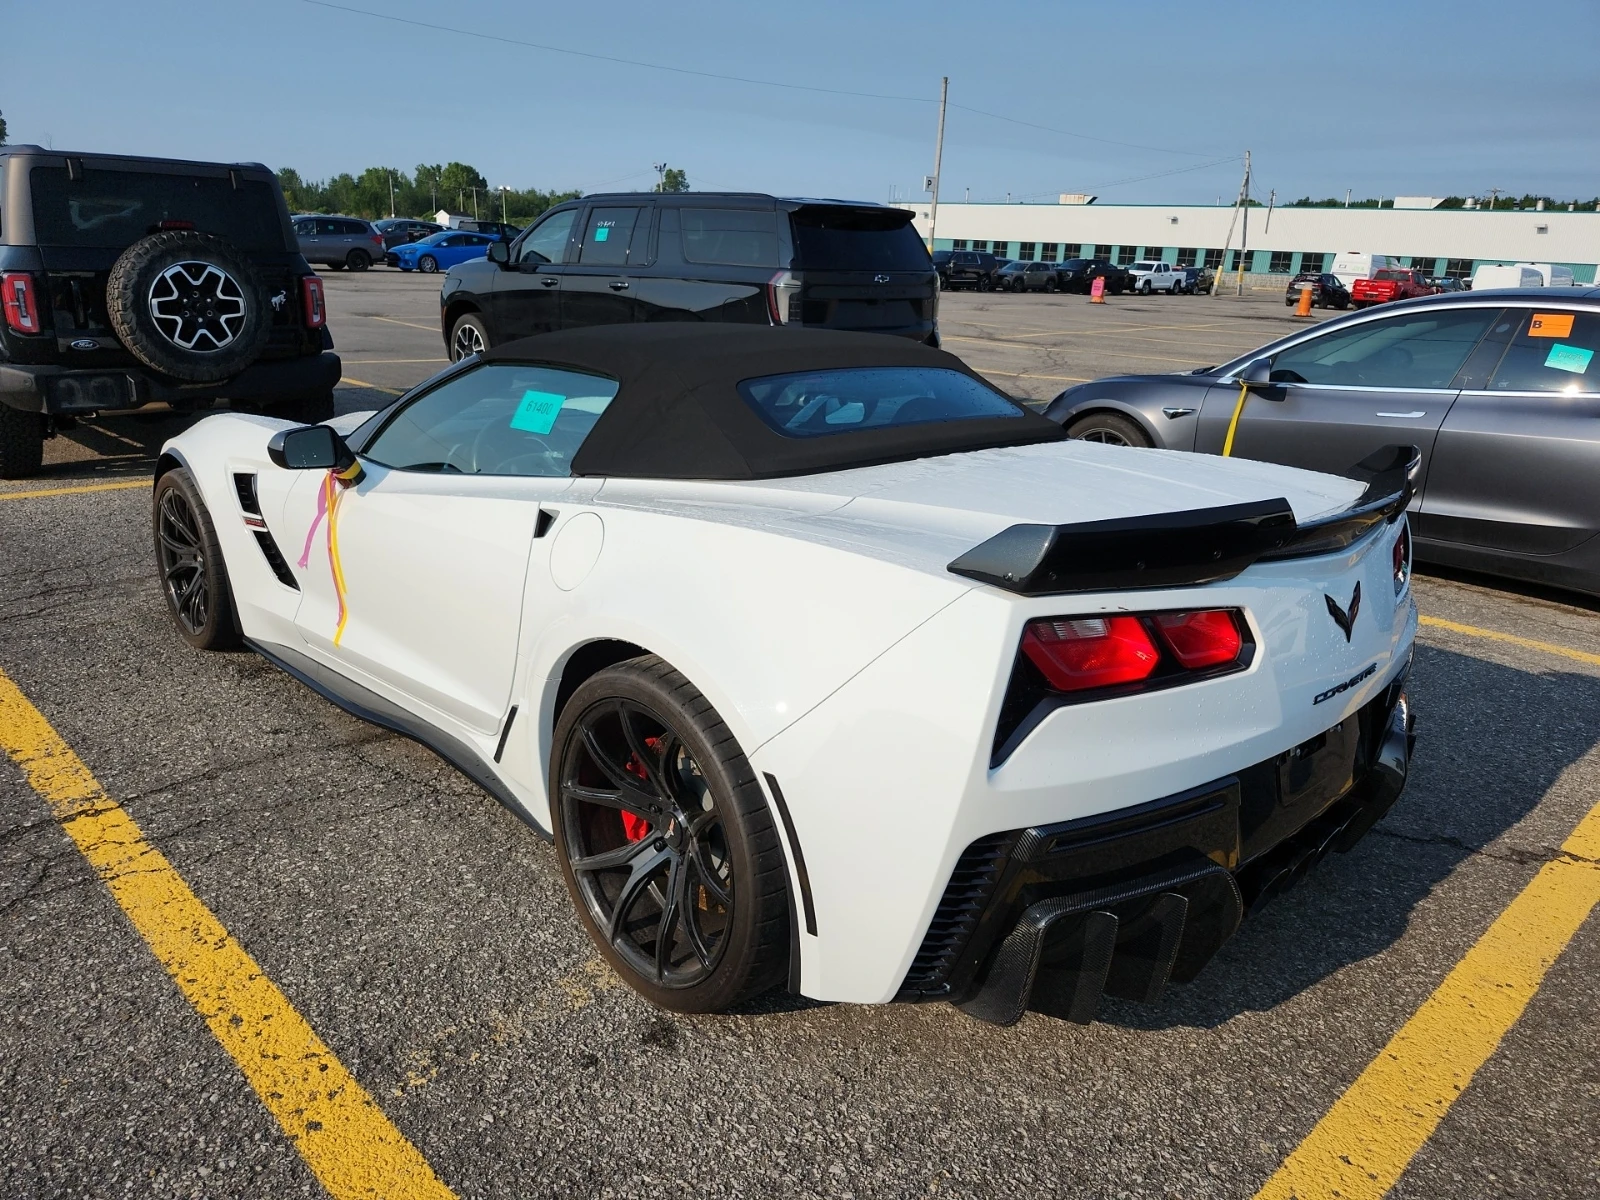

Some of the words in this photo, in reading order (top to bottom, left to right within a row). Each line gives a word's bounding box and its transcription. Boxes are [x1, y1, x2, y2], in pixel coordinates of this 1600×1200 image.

[1532, 320, 1543, 328] B
[525, 400, 554, 415] 61400
[1312, 662, 1377, 705] CORVETTE
